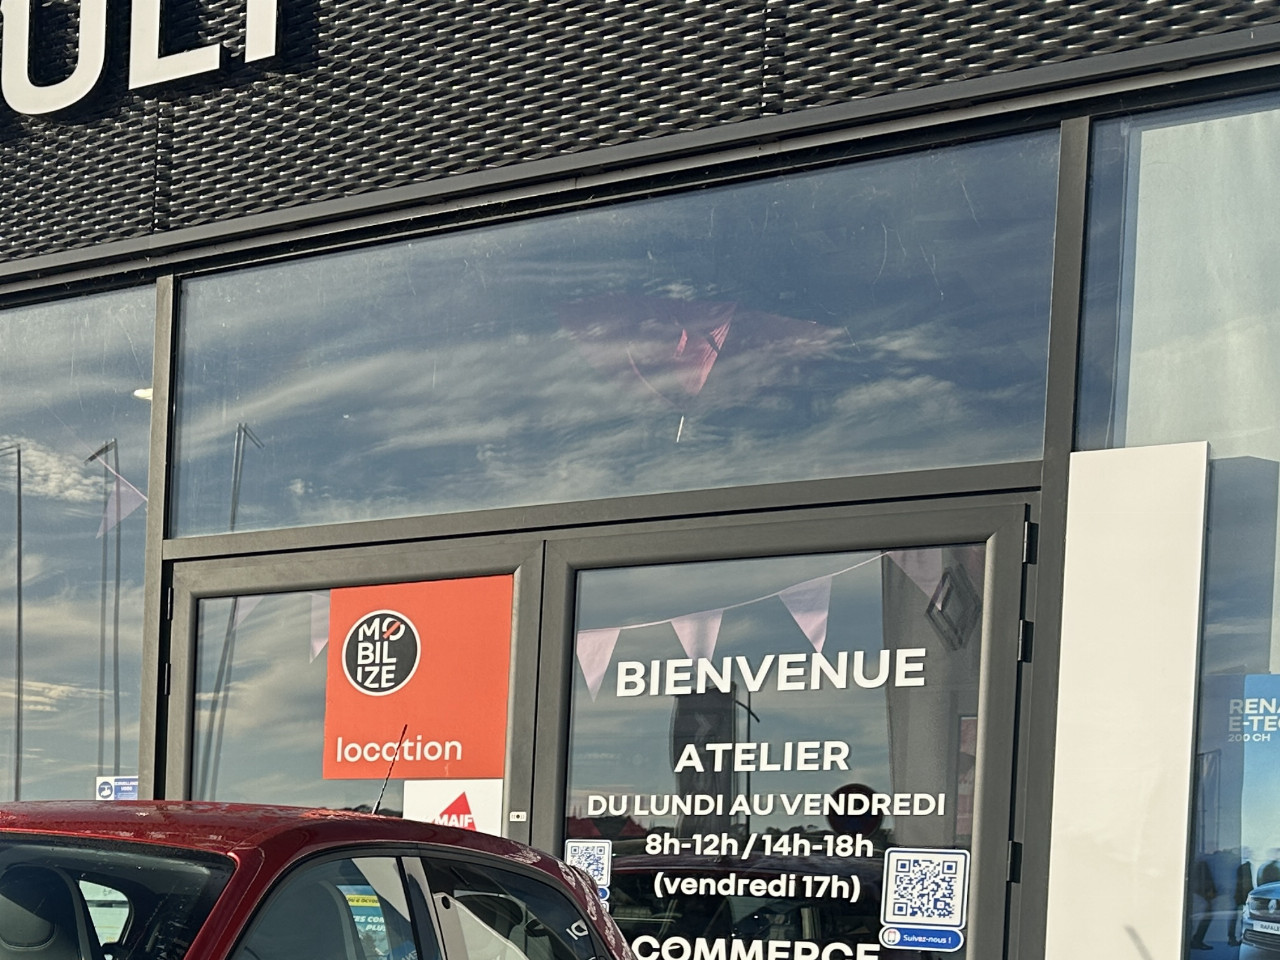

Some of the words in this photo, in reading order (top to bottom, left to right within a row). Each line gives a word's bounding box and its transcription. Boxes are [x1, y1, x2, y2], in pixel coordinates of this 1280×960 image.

[616, 648, 926, 697] BIENVENUE
[336, 735, 463, 763] location
[1227, 734, 1250, 742] 200
[1252, 733, 1271, 742] CH
[674, 741, 850, 773] ATELIER
[587, 795, 627, 816] DU
[634, 794, 723, 816] LUNDI
[729, 794, 774, 816] AU
[780, 794, 946, 816] VENDREDI
[434, 813, 473, 828] MAIF
[653, 872, 796, 899] (vendredi
[801, 875, 861, 903] 17h)
[903, 934, 947, 944] Suivez-nous
